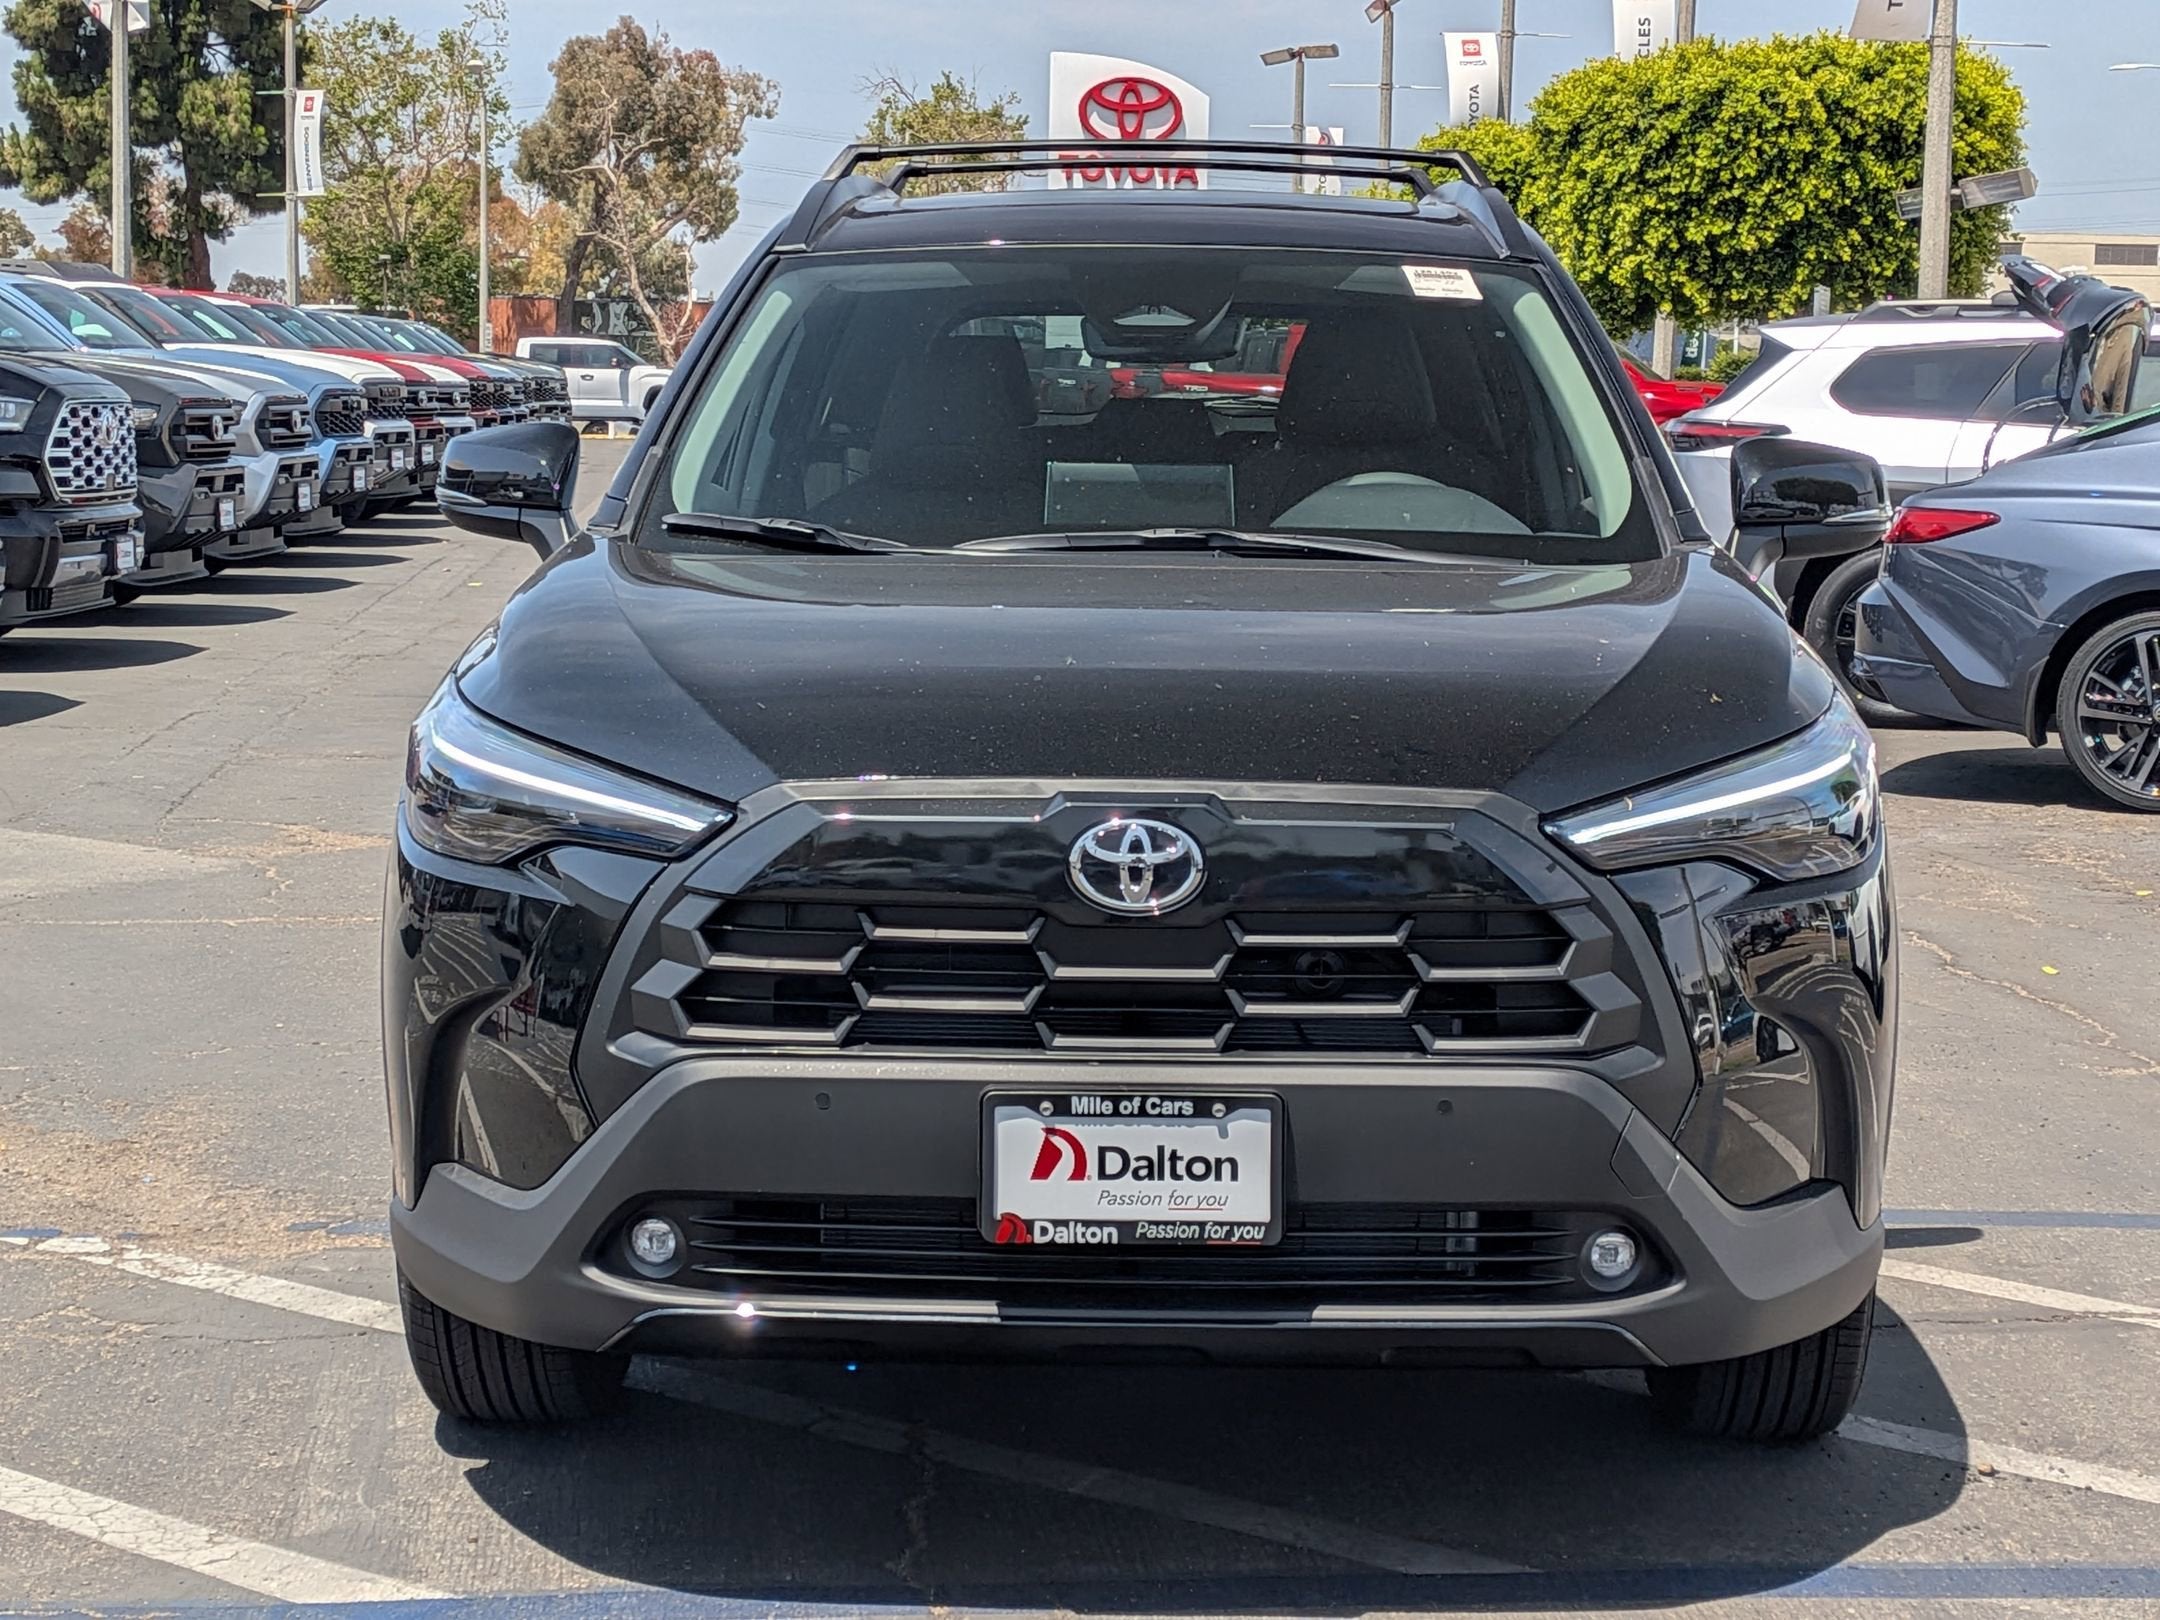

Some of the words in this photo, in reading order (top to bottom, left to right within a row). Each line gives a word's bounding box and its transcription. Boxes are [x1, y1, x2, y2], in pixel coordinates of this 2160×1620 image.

[1184, 384, 1209, 392] TRD
[1071, 1096, 1114, 1115] Mile
[1119, 1097, 1142, 1115] of
[1145, 1096, 1195, 1116] Cars
[1097, 1144, 1239, 1182] Dalton
[1097, 1190, 1162, 1206] Passion
[1168, 1189, 1195, 1207] for
[1195, 1195, 1229, 1210] you
[1033, 1220, 1119, 1244] Dalton
[1135, 1221, 1201, 1240] Passion
[1204, 1222, 1231, 1239] for
[1231, 1225, 1266, 1242] you
